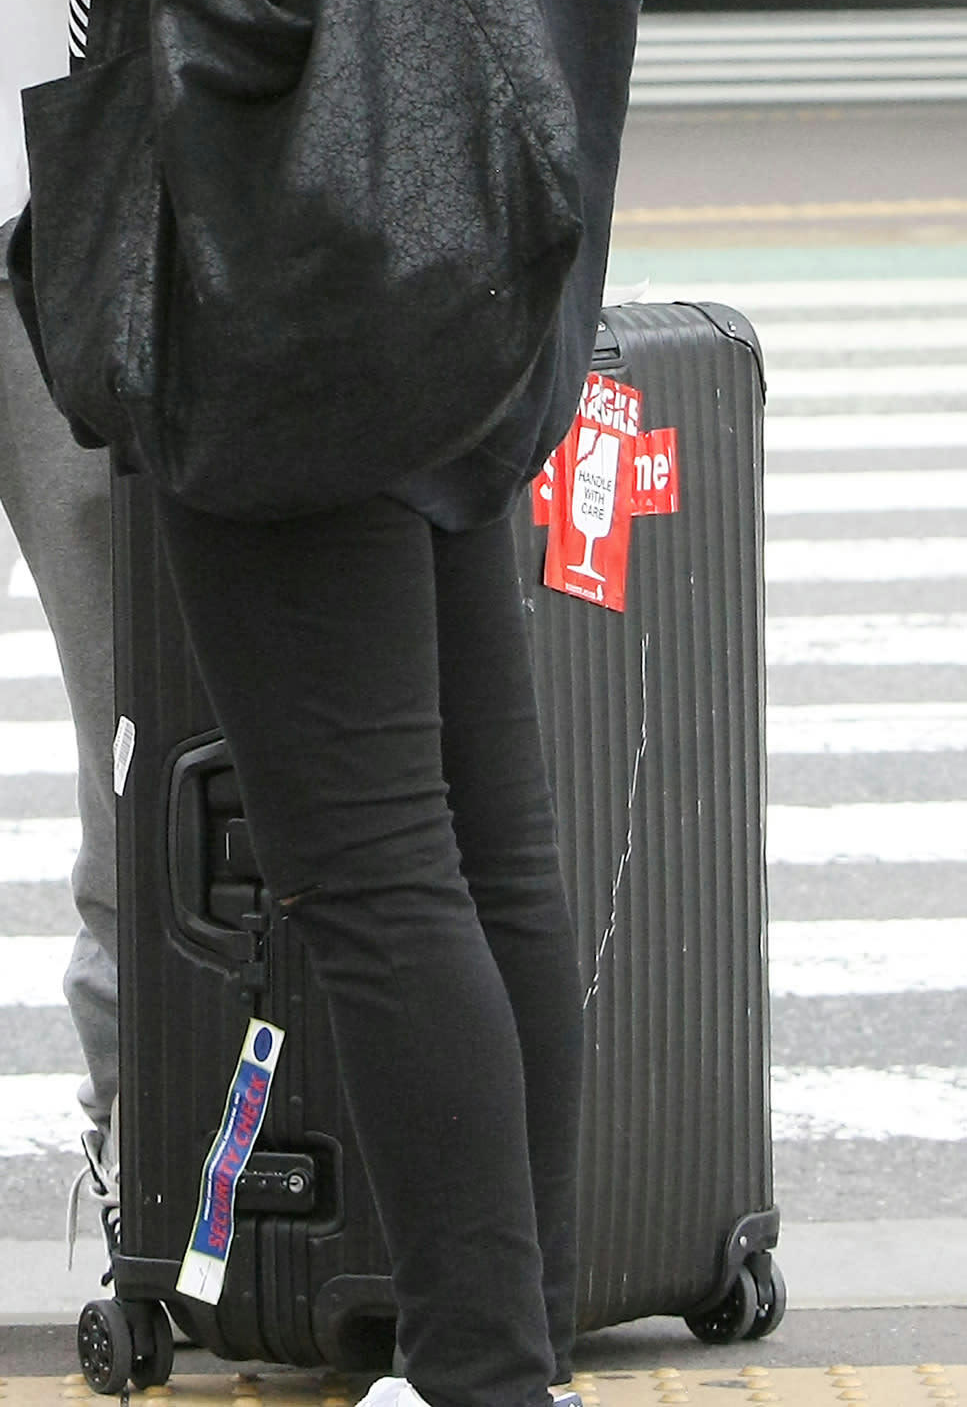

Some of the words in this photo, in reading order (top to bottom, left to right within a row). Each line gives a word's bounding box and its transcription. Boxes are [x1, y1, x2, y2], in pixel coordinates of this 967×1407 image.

[578, 470, 612, 493] HANDLE
[584, 486, 605, 505] WITH
[581, 502, 604, 521] CARE
[209, 1146, 241, 1250] SECURITY
[234, 1072, 268, 1147] CHECK
